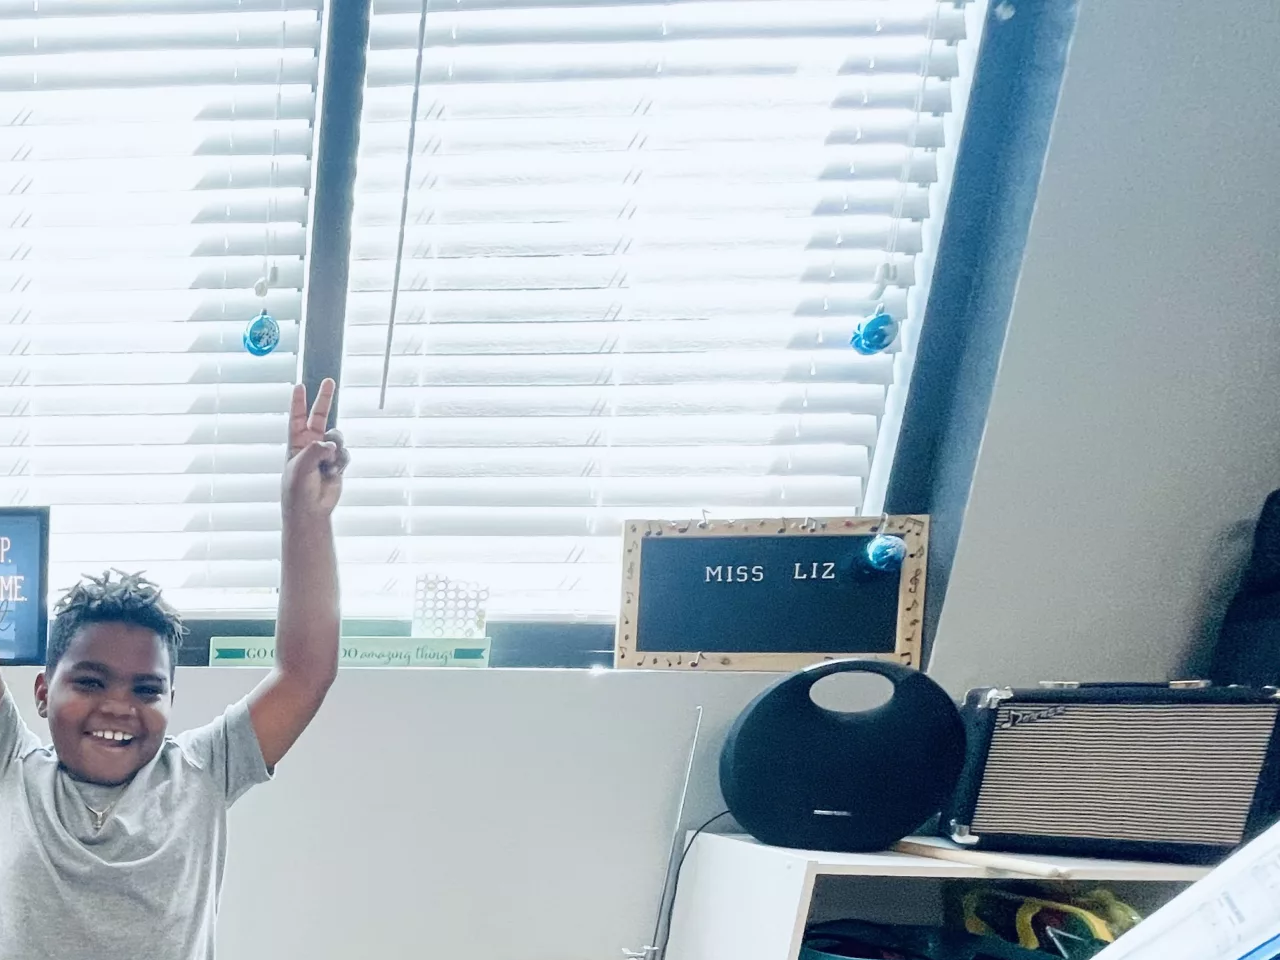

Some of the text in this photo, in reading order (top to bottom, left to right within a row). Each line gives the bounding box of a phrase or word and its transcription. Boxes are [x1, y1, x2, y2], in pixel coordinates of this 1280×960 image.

[705, 562, 835, 582] MISS LIZ
[246, 648, 267, 659] GO
[360, 650, 411, 665] amazing
[415, 645, 453, 666] things
